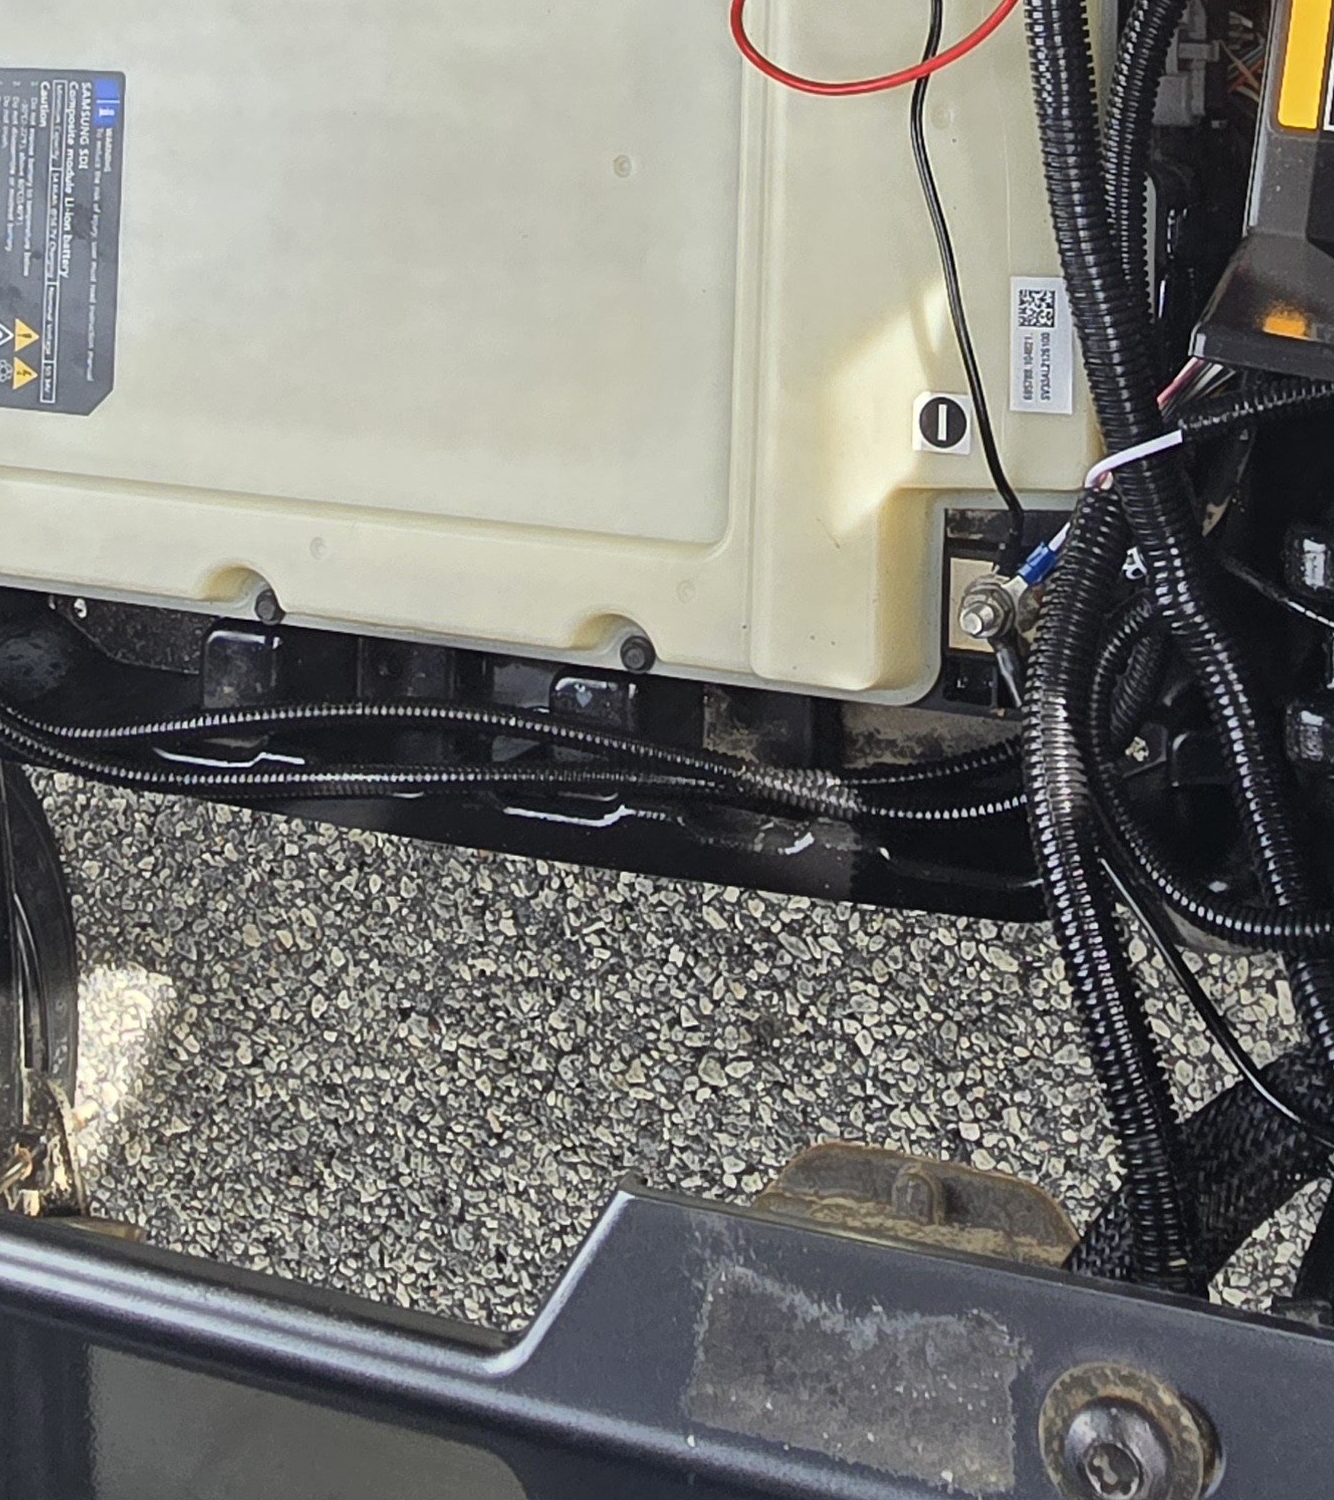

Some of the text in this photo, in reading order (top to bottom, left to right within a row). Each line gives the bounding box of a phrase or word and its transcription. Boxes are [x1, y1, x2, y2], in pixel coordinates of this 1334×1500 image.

[39, 81, 51, 127] Caution
[78, 82, 91, 169] SAMSUNG SDI
[60, 80, 79, 279] Composite module Li-ion battery
